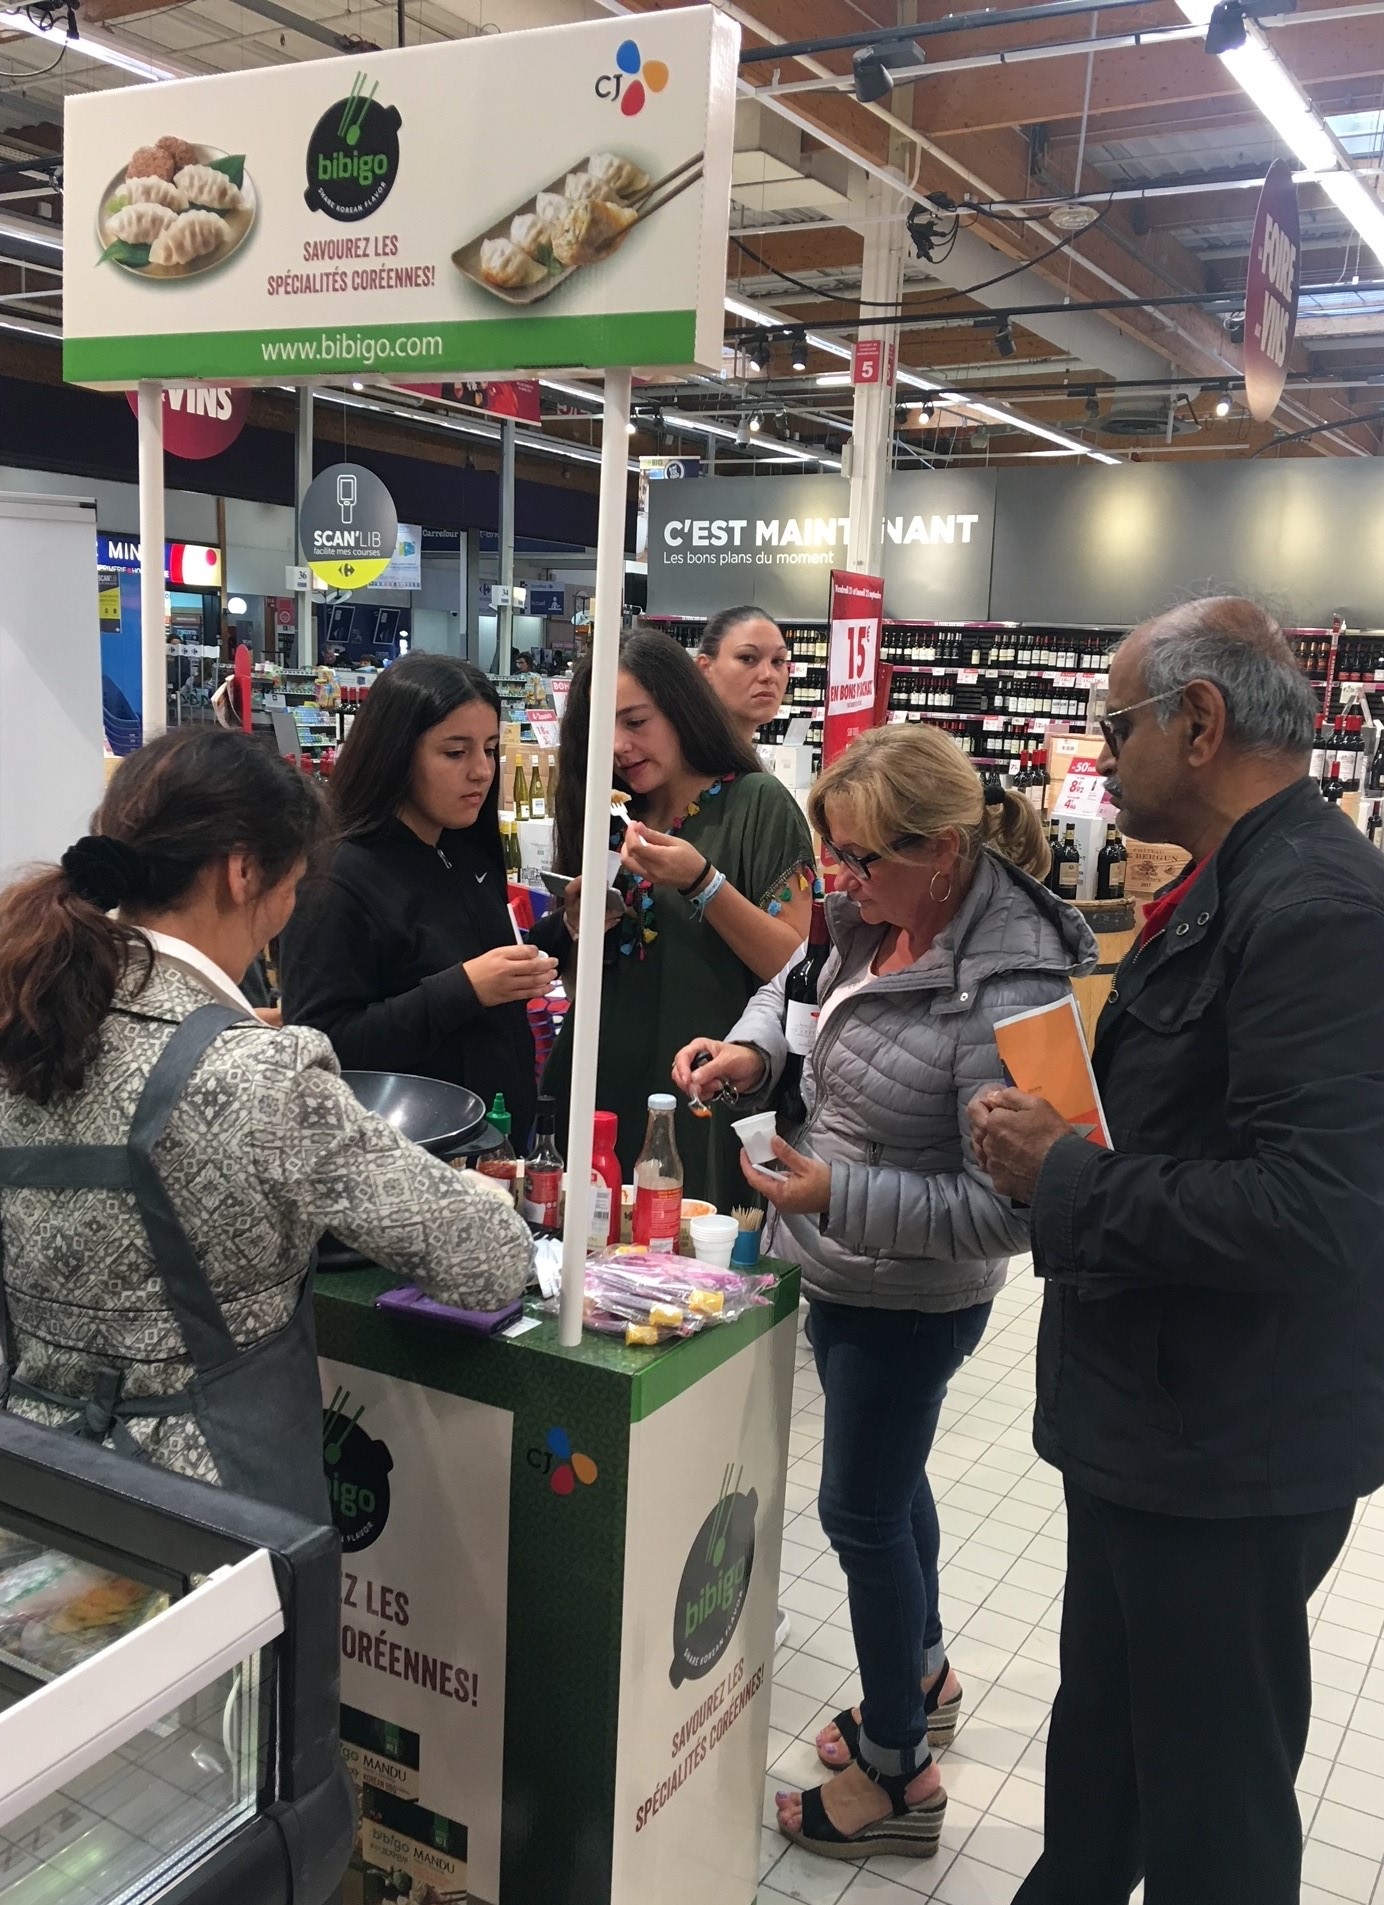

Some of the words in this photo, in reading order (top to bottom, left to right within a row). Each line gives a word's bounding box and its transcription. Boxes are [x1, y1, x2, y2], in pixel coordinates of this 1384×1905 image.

[594, 74, 623, 102] CJ
[318, 150, 388, 186] bibigo
[317, 187, 335, 209] SHARE
[335, 204, 363, 213] KOREAN
[364, 181, 386, 208] FLAVOR
[303, 236, 370, 262] SAVOUREZ
[374, 234, 398, 257] LES
[1261, 213, 1297, 303] FOIRE
[267, 266, 348, 296] SPÉCIALITÉS
[351, 263, 436, 292] CORÉENNES!
[1260, 290, 1290, 368] VINS
[261, 332, 443, 365] www.bibigo.com
[861, 360, 873, 378] 5
[168, 387, 232, 420] VINS
[313, 530, 382, 548] SCAN'LIB
[423, 530, 459, 538] Carrefour
[663, 519, 748, 546] C'EST
[108, 540, 141, 561] MIN
[313, 547, 336, 555] facilite
[336, 548, 351, 556] mes
[352, 548, 381, 557] courses
[663, 552, 684, 564] Les
[687, 551, 717, 564] bons
[720, 551, 752, 566] plans
[755, 550, 773, 564] du
[776, 550, 834, 564] moment
[298, 570, 308, 580] 36
[527, 1448, 553, 1474] CJ
[328, 1471, 376, 1517] igo
[347, 1521, 374, 1542] FLAVOR
[366, 1580, 410, 1627] LES
[684, 1554, 746, 1638] bibigo
[341, 1624, 479, 1708] ORÉENNES!
[683, 1647, 700, 1667] SHARE
[700, 1637, 724, 1666] KOREAN
[671, 1679, 726, 1759] SAVOUREZ
[727, 1657, 744, 1695] LES
[635, 1735, 707, 1833] SPÉCIALITÉS
[709, 1662, 765, 1751] CORÉENNES!
[363, 1754, 406, 1782] MANDU
[373, 1828, 410, 1853] bibigo
[413, 1847, 455, 1874] MANDU
